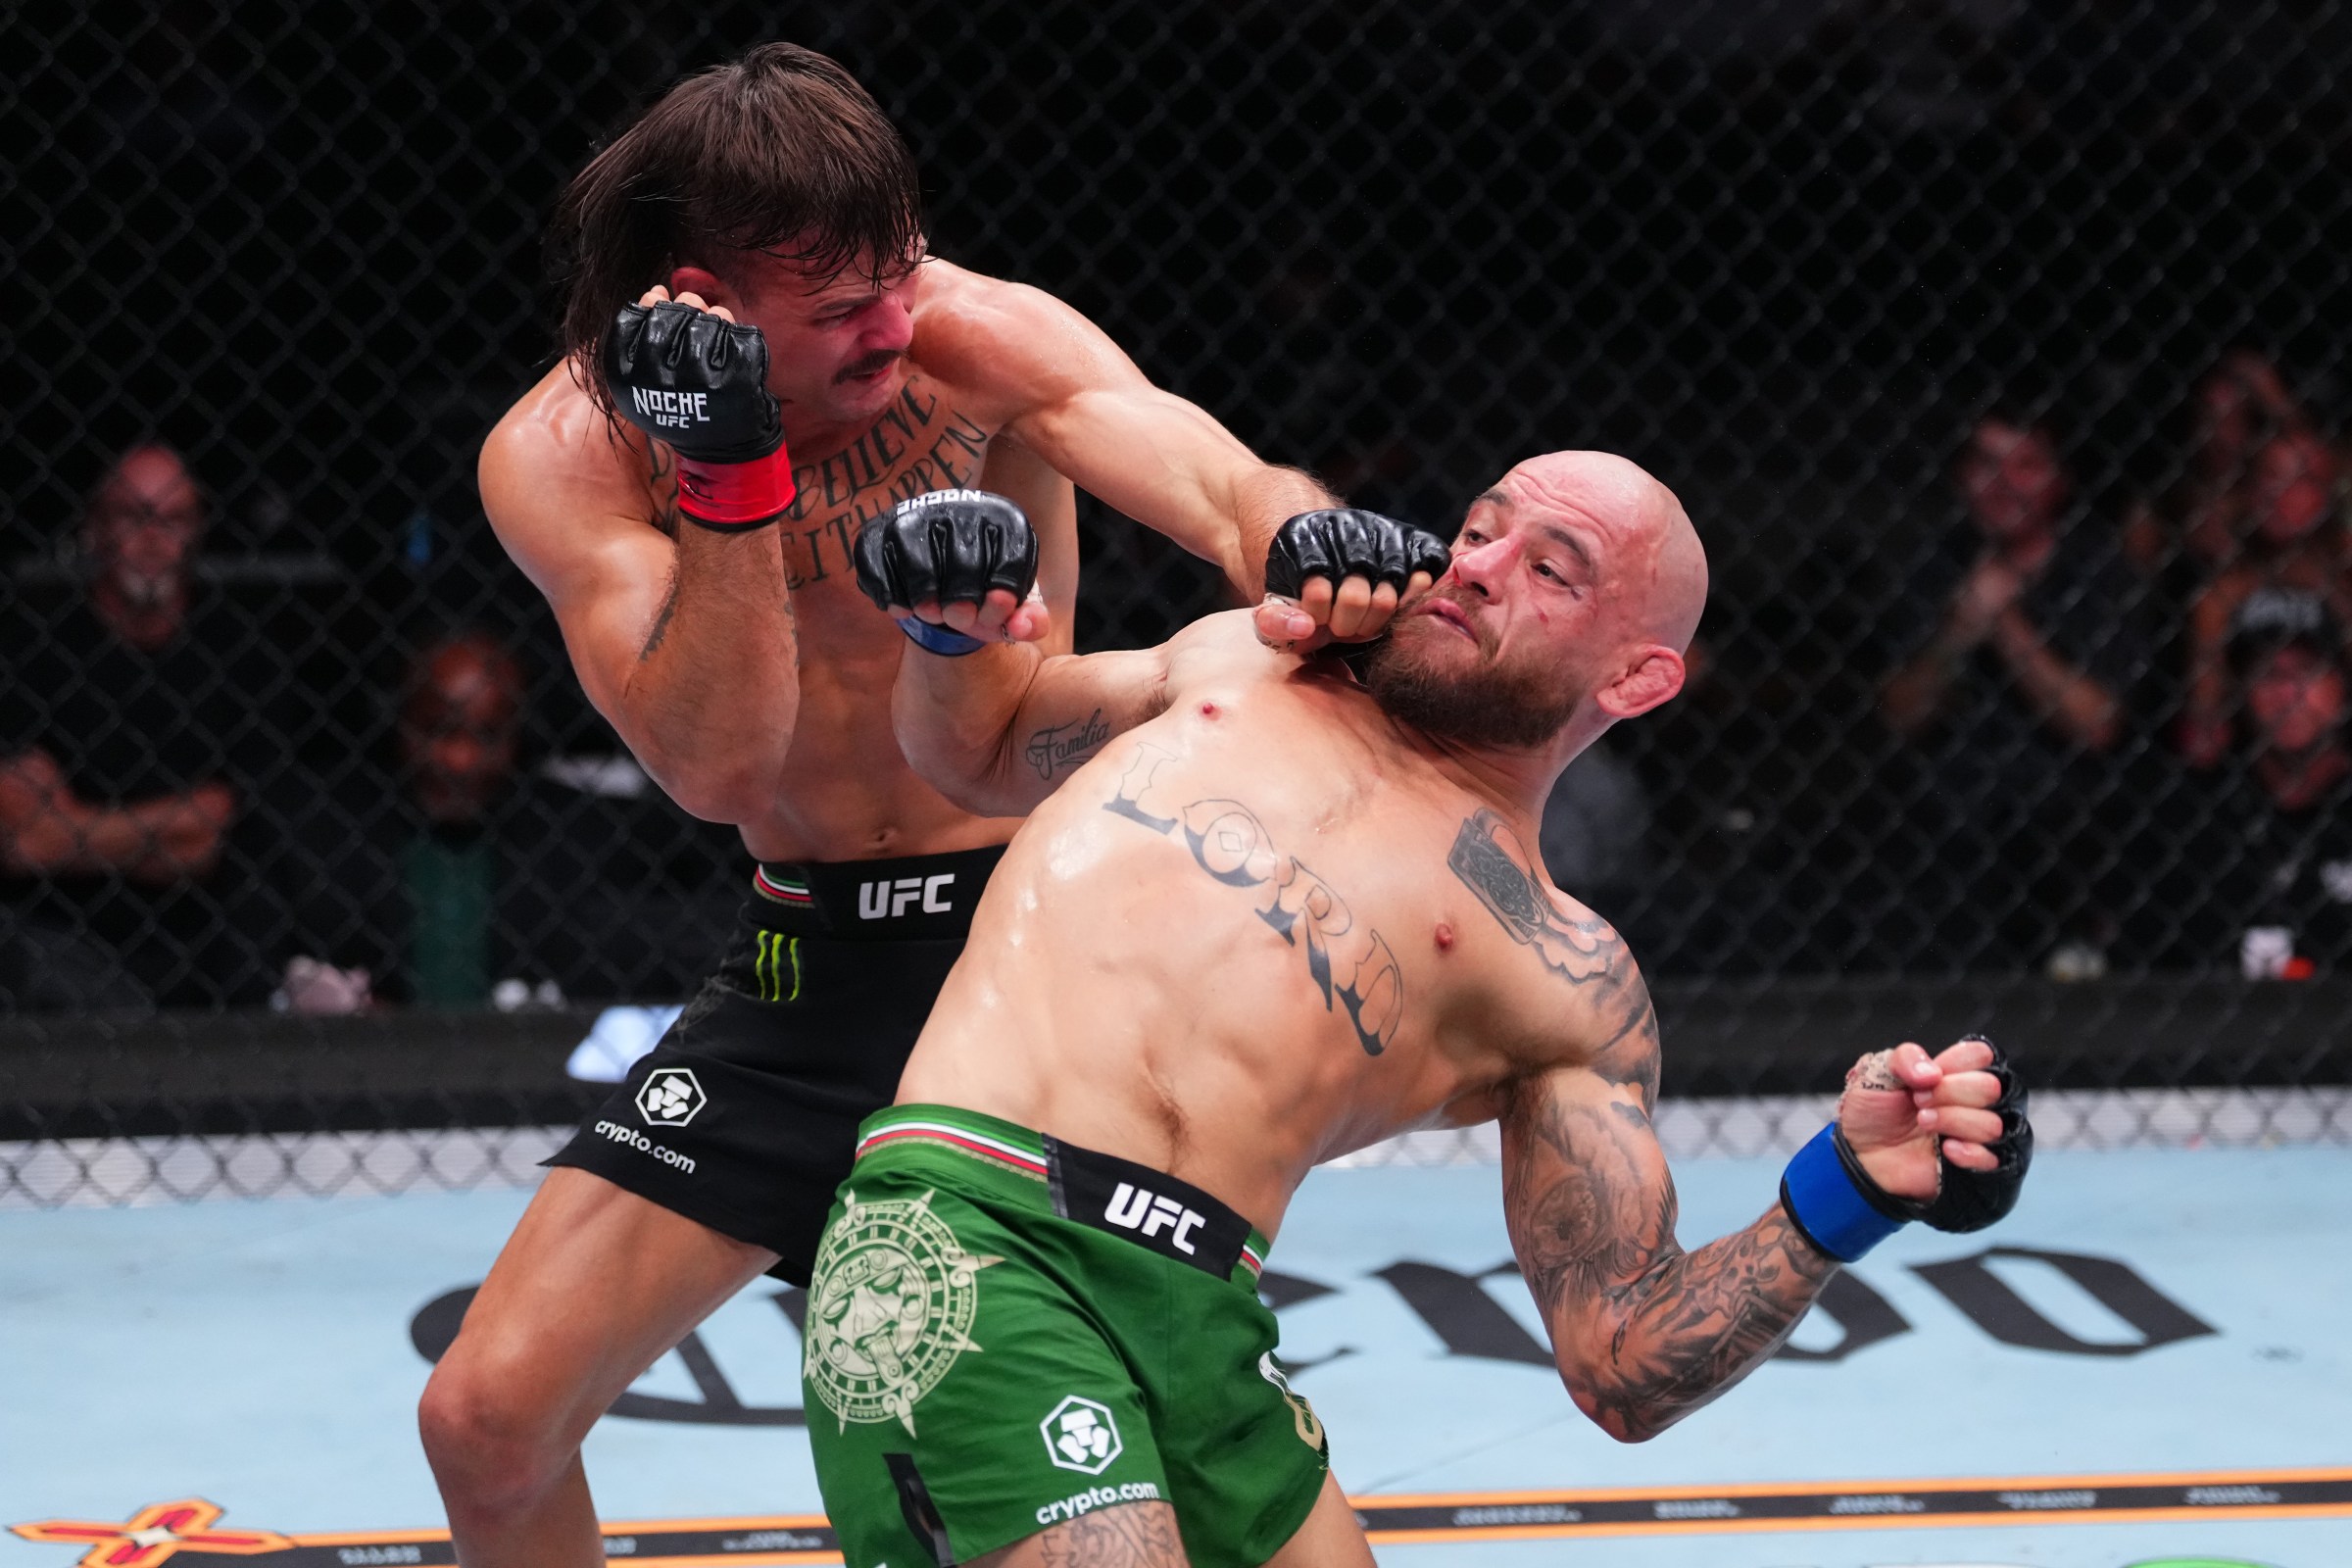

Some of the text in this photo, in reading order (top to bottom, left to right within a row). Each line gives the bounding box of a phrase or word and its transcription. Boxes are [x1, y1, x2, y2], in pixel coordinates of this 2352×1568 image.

[631, 385, 711, 422] NOCHE
[656, 413, 691, 429] UFC
[787, 374, 938, 522] BELIEVE
[896, 488, 983, 517] NOCHE
[1025, 708, 1110, 781] Familia
[858, 873, 956, 920] UFC
[1102, 740, 1404, 1057] LORD
[594, 1120, 697, 1175] crypto.com
[1103, 1181, 1207, 1256] UFC
[1035, 1481, 1160, 1525] crypto.com
